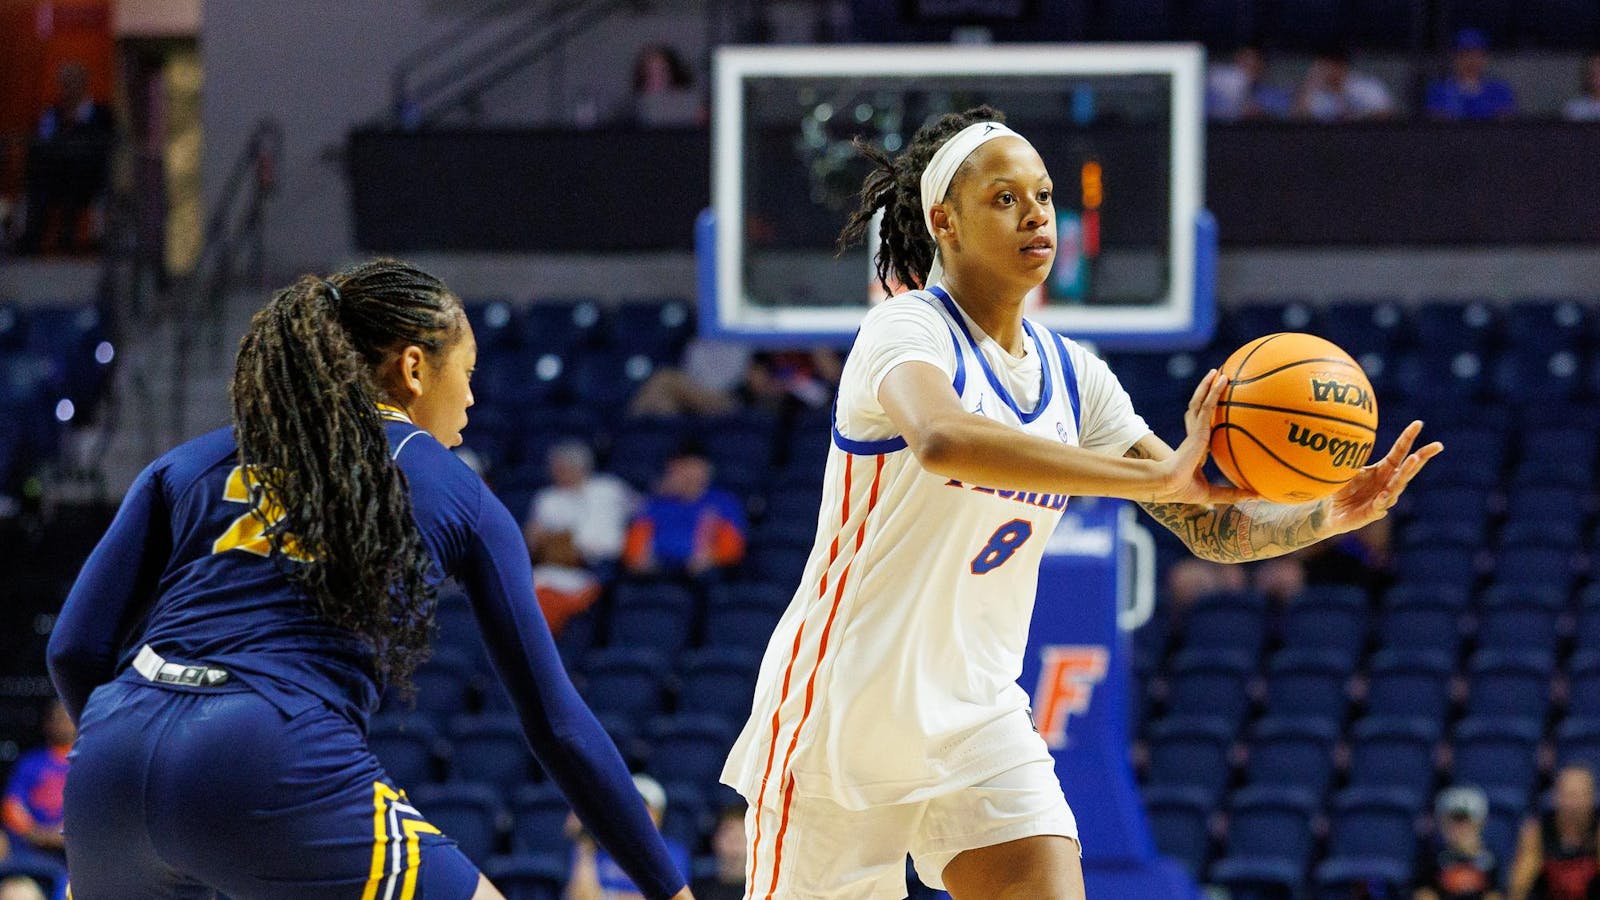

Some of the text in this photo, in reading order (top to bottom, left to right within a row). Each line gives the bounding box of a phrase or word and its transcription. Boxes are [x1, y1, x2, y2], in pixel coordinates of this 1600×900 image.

[1311, 378, 1373, 414] NCAA
[1287, 422, 1372, 470] Wilson
[970, 518, 1033, 576] 8
[1032, 644, 1110, 751] F
